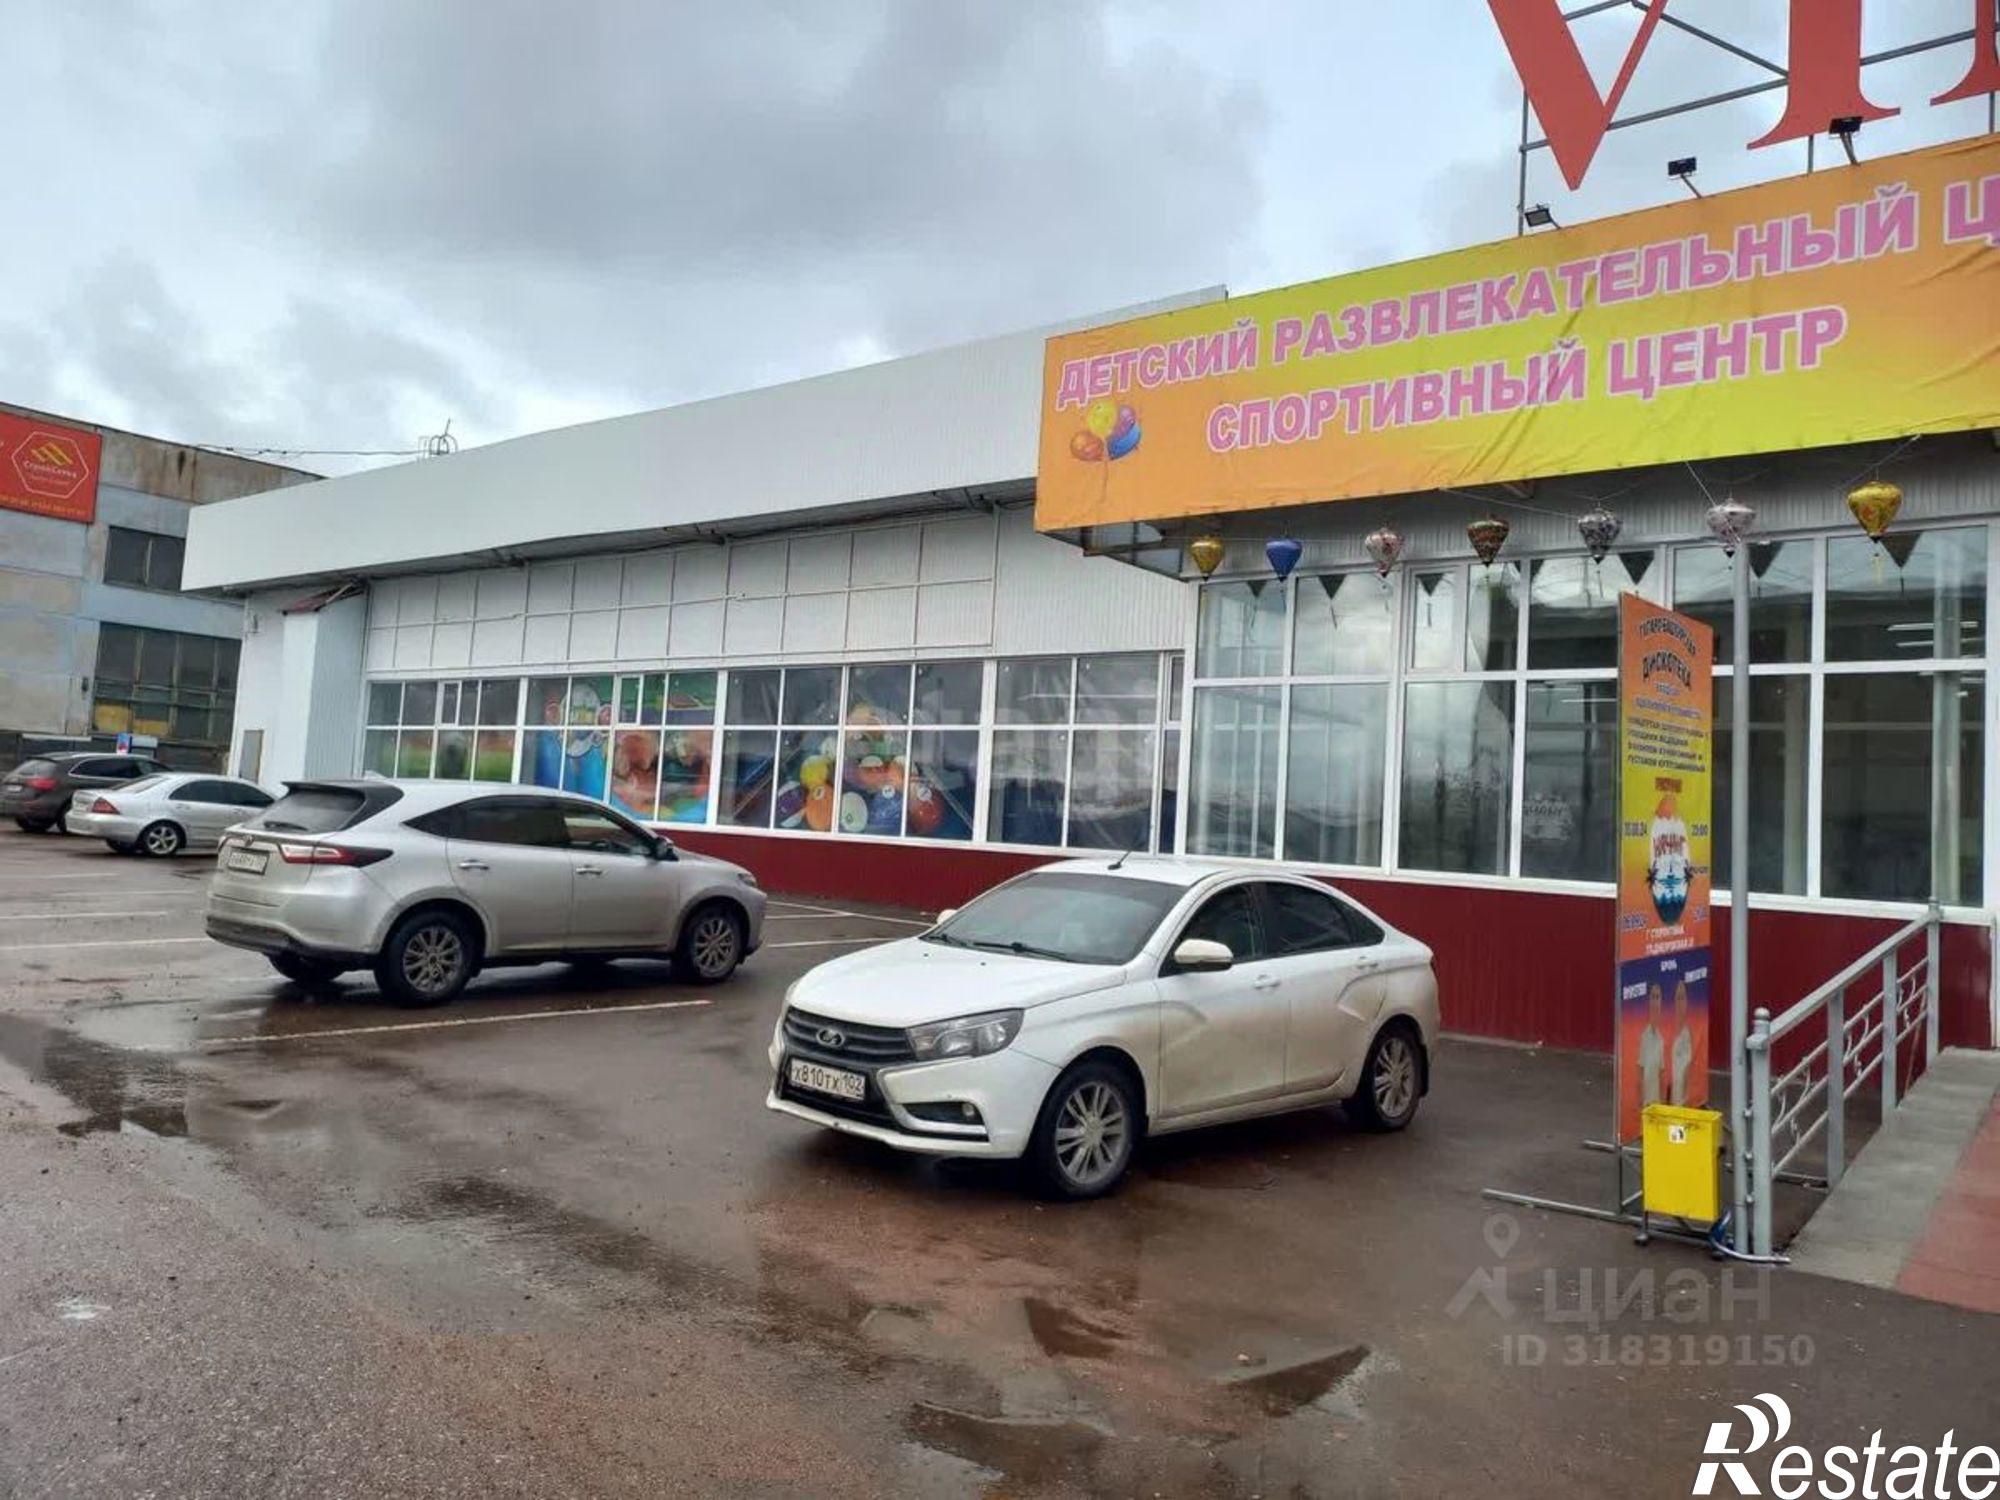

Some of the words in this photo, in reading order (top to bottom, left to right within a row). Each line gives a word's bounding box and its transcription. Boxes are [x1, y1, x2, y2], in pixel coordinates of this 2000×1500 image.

[1058, 318, 1258, 410] ДЕТСКИЙ
[1273, 183, 1919, 365] РАЗВЛЕКАТЕЛЬНЫЙ
[1207, 336, 1588, 452] СПОРТИВНЫЙ
[1607, 305, 1847, 400] ЦЕНТР
